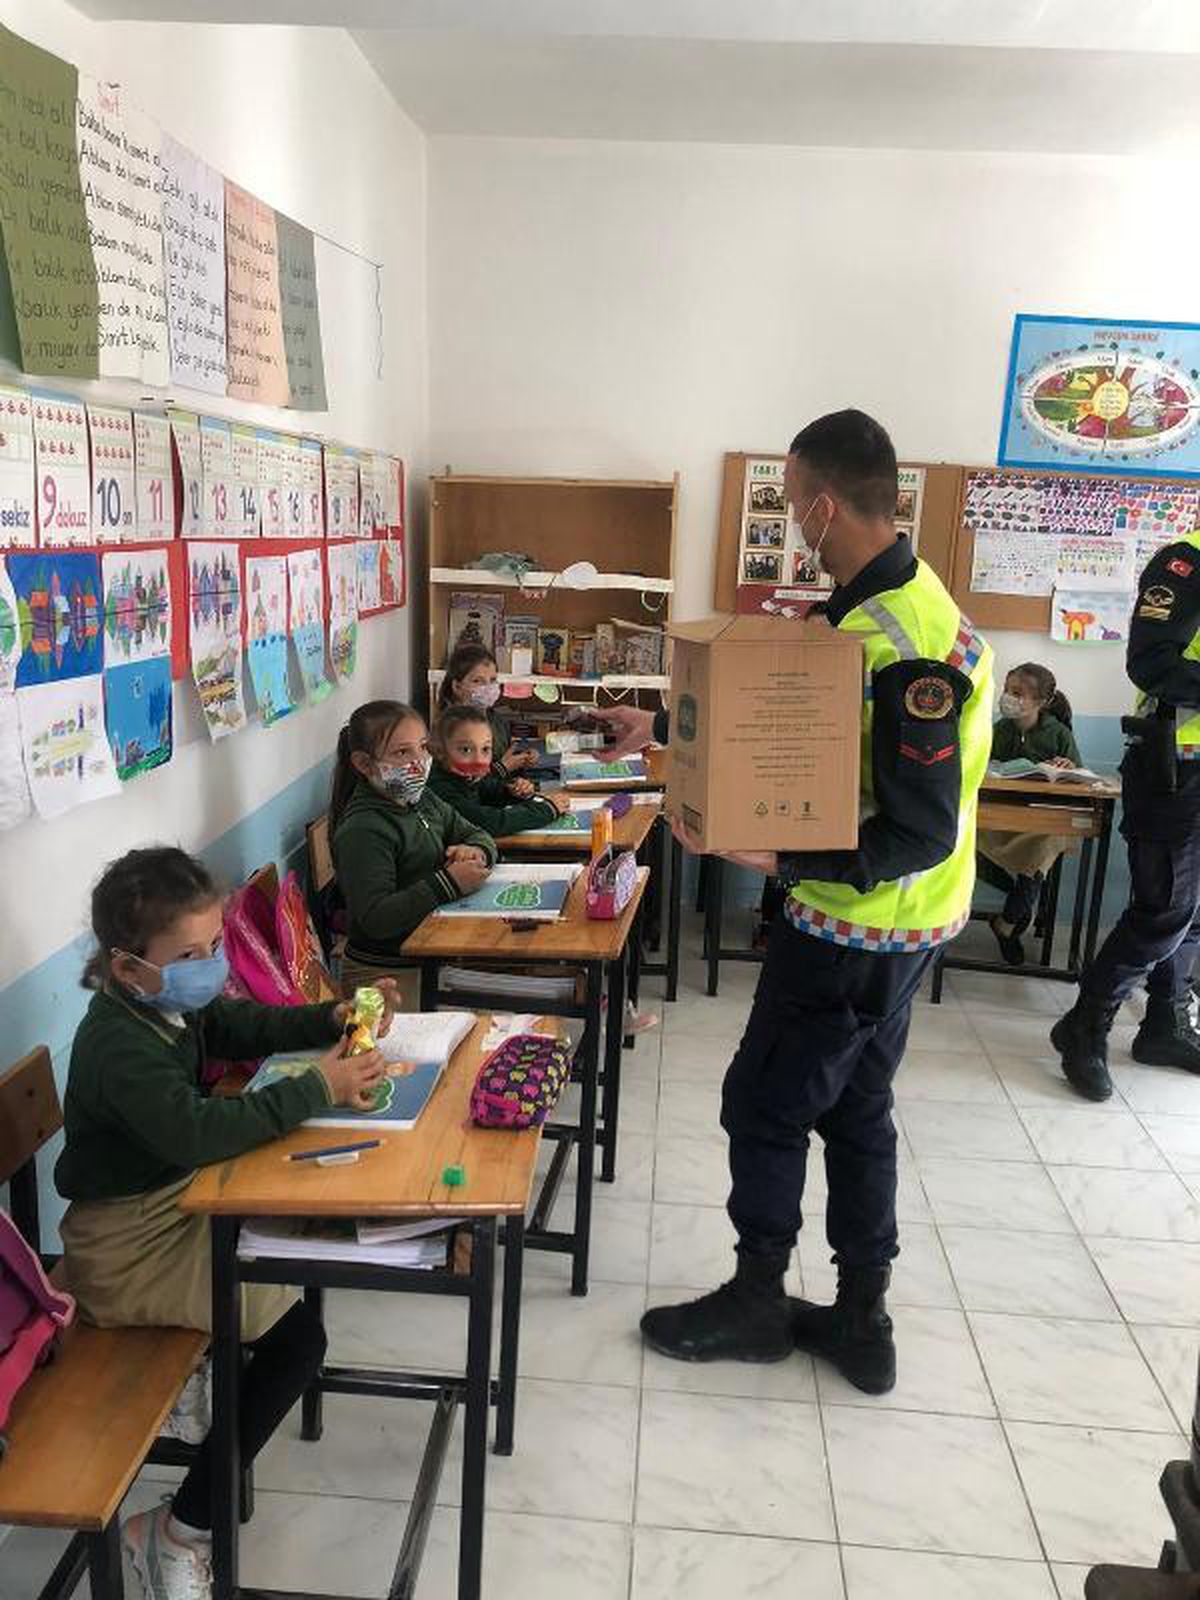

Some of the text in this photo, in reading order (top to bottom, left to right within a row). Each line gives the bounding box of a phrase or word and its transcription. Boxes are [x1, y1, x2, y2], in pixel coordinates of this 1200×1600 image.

[897, 471, 918, 484] 928
[0, 499, 30, 527] sekiz
[43, 475, 87, 528] 9 dokuz
[97, 477, 121, 527] 10
[149, 479, 164, 522] 11
[211, 480, 227, 521] 13
[240, 486, 256, 521] 14
[288, 490, 300, 522] 16
